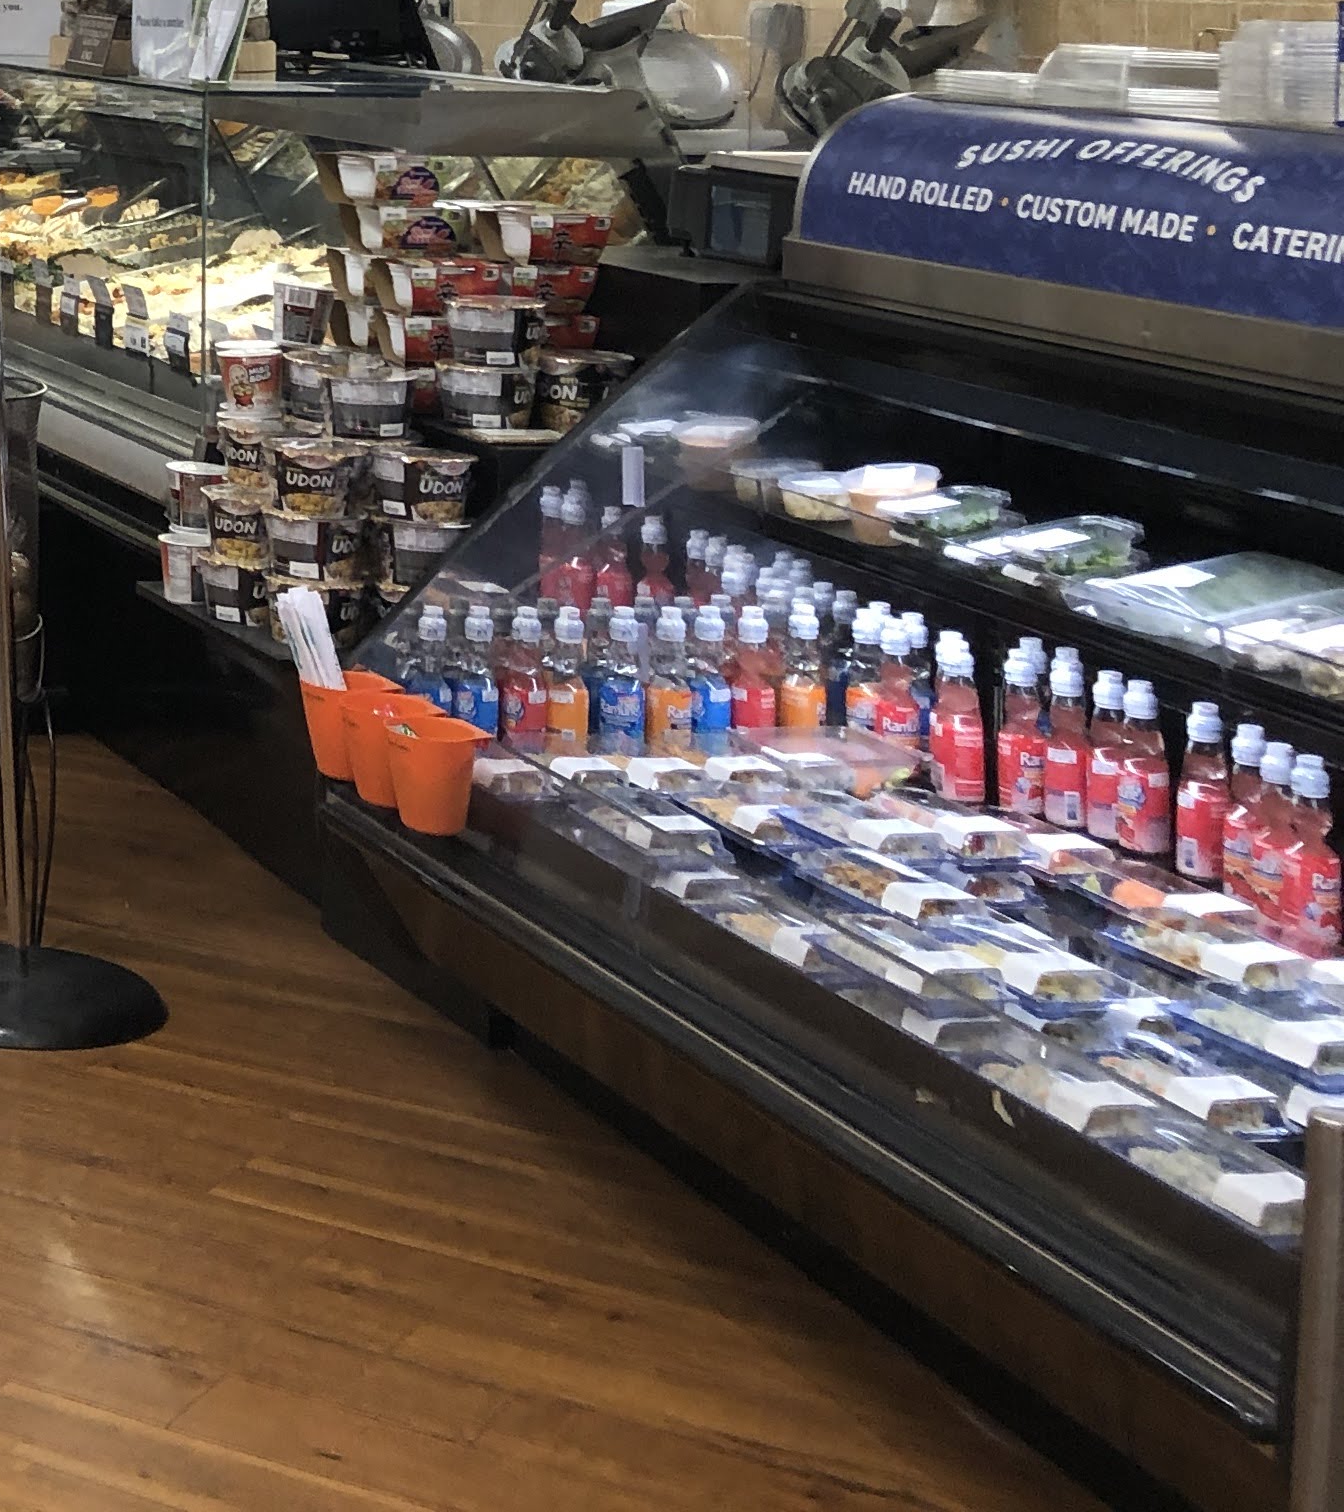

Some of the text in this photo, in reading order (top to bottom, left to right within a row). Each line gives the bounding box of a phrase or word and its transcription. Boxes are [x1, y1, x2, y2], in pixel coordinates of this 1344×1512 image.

[954, 138, 1266, 204] SUSHI OFFERINGS
[847, 171, 906, 201] HAND
[908, 177, 995, 213] ROLLED
[1015, 193, 1117, 231] CUSTOM
[1119, 206, 1200, 243] MADE
[285, 470, 334, 488] UDON
[419, 478, 464, 496] UDON
[214, 516, 257, 535] UDON
